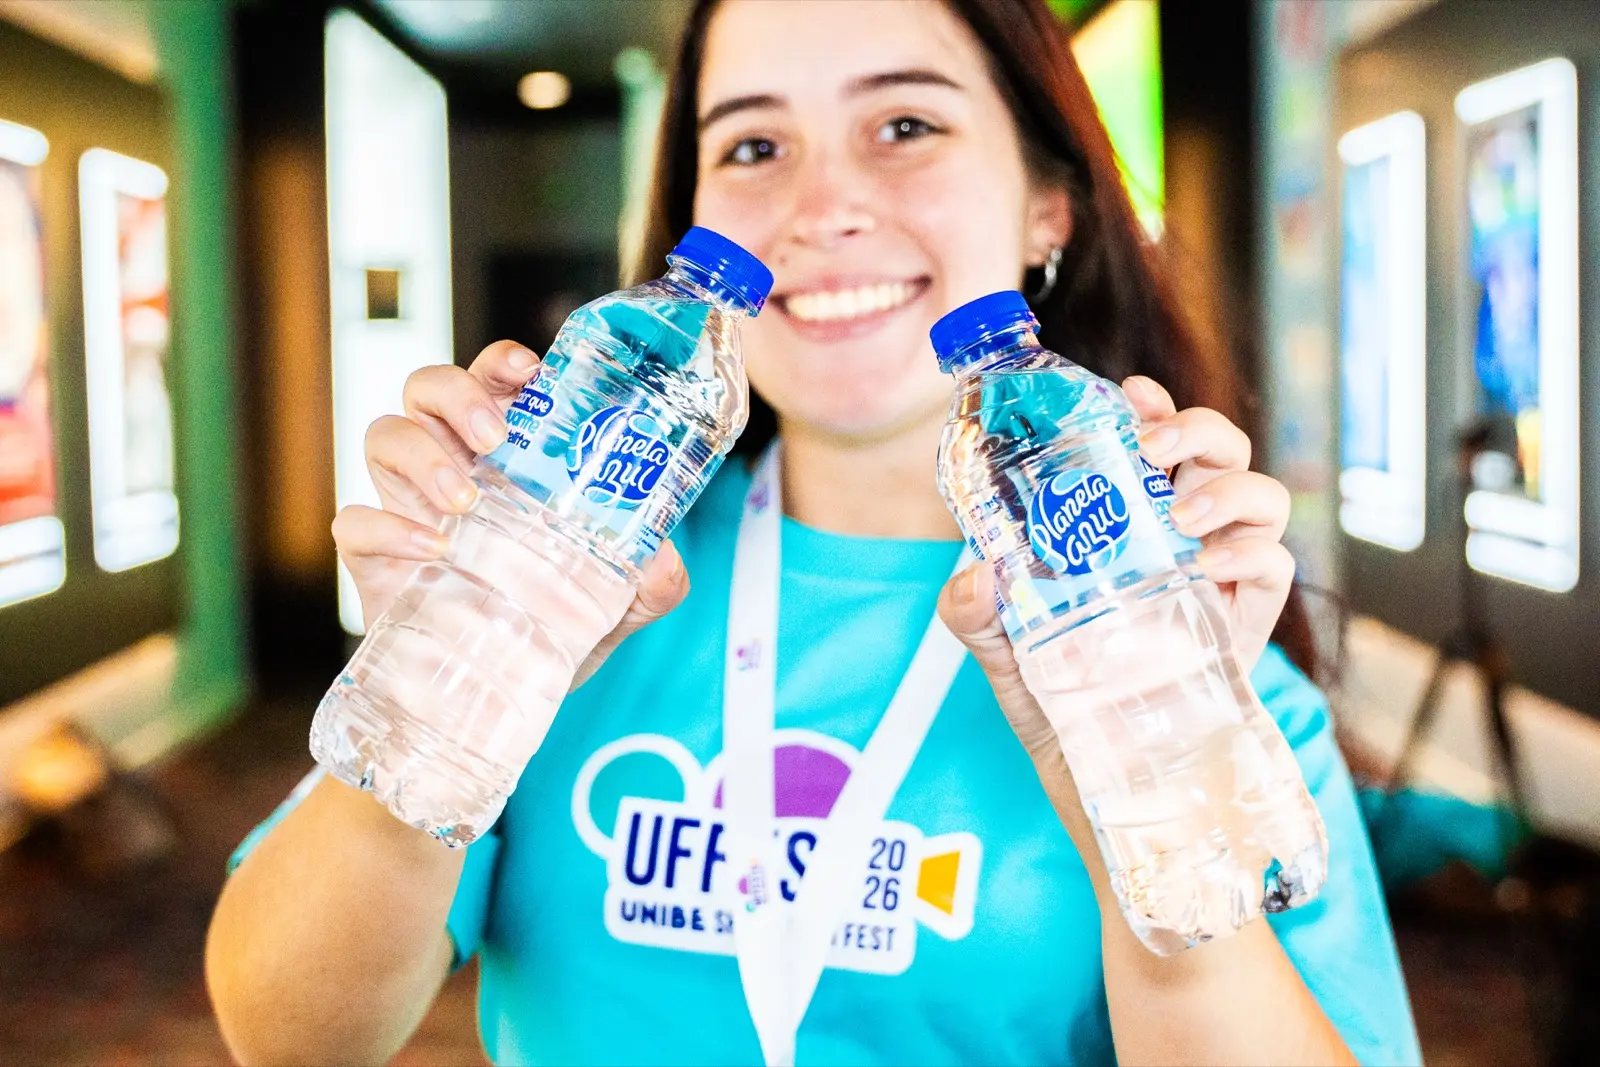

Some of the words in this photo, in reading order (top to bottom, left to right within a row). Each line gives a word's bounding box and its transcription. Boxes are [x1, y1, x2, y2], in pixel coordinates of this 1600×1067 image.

[527, 395, 551, 414] que
[566, 408, 669, 472] Plneta
[584, 459, 656, 505] zul
[868, 838, 906, 871] 20
[863, 876, 900, 911] 26
[621, 900, 705, 932] UNIBE
[843, 923, 896, 951] FEST
